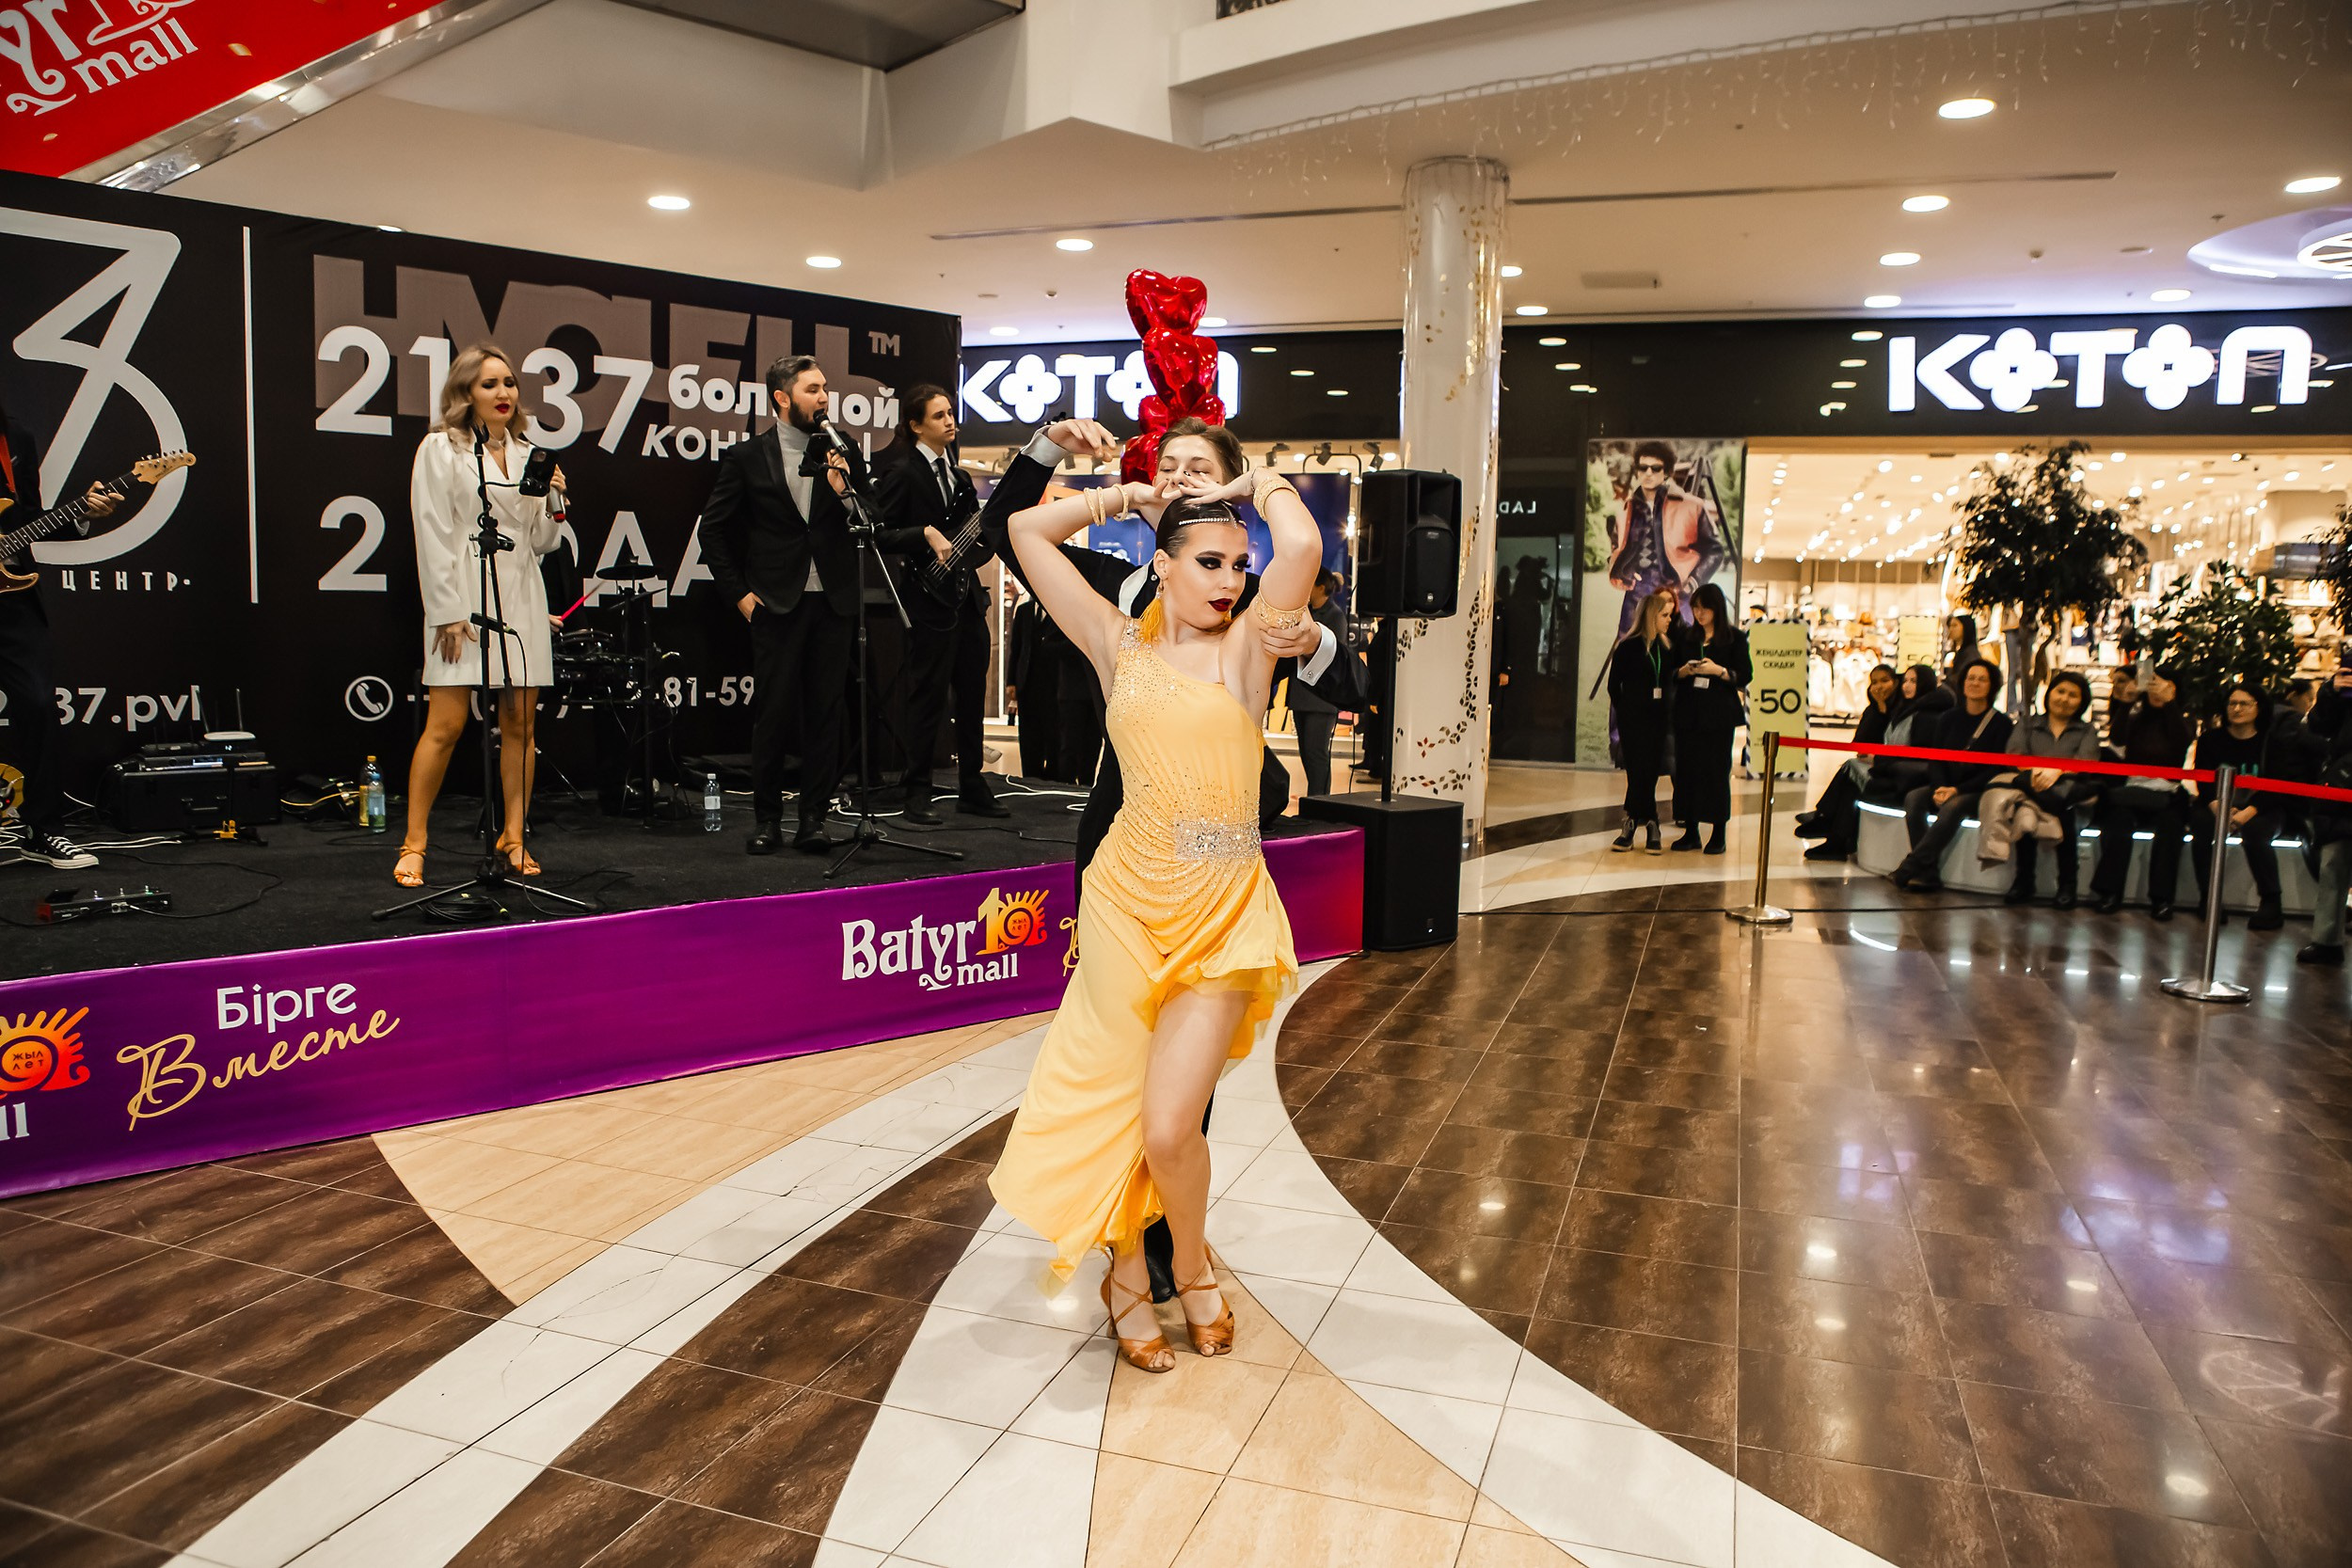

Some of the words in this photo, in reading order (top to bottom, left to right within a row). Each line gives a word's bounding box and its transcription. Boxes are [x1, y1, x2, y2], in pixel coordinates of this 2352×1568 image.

[72, 17, 199, 93] mall
[668, 364, 899, 429] болой
[1888, 324, 2312, 412] KOTON
[318, 496, 387, 591] 2
[841, 914, 977, 991] Batyr
[957, 952, 1019, 986] mall
[215, 982, 358, 1034] Бірге
[116, 1007, 402, 1132] Вместе
